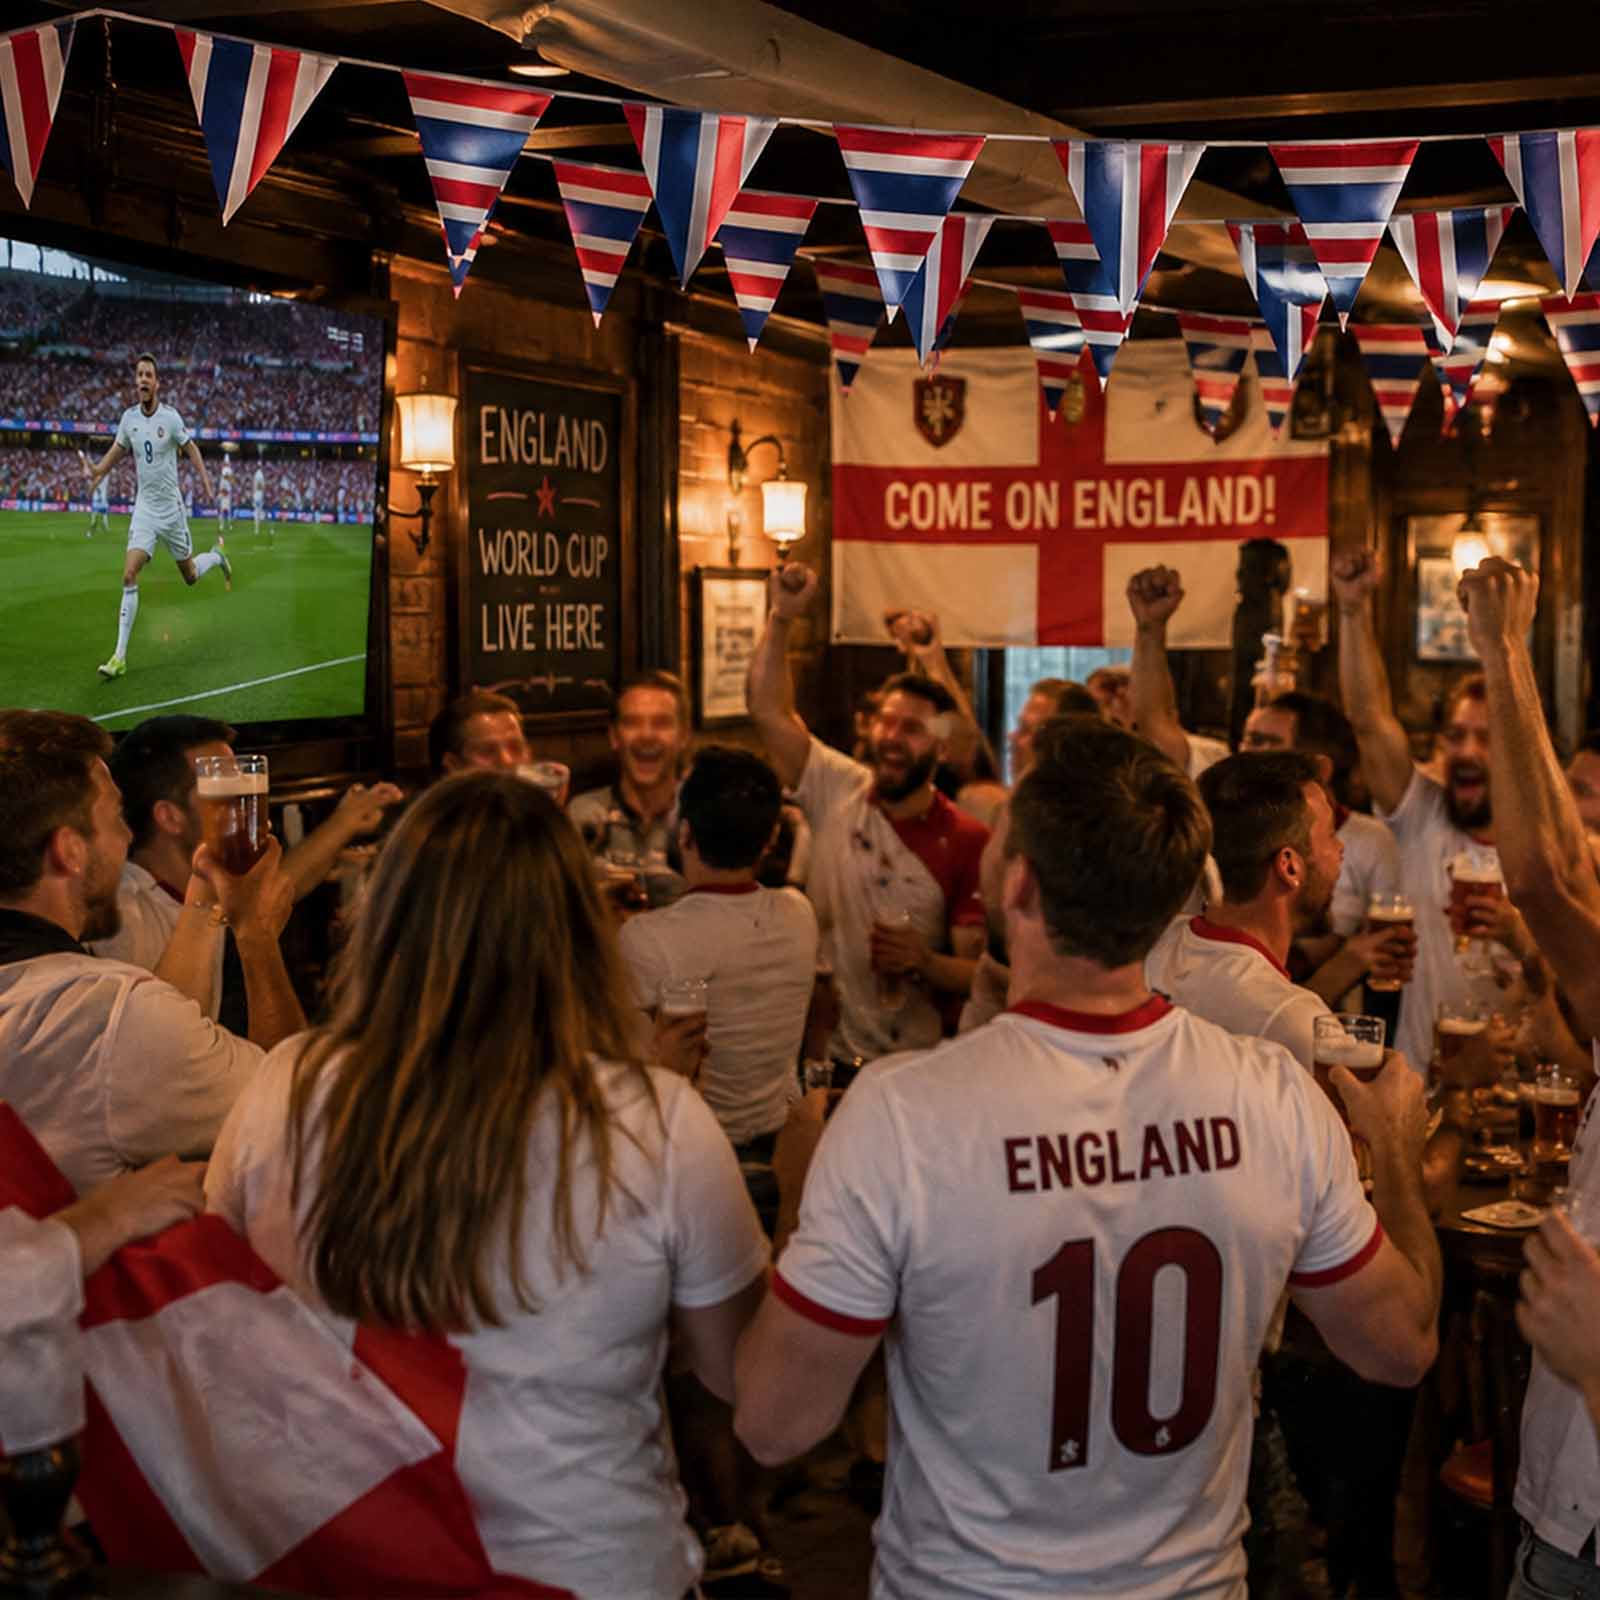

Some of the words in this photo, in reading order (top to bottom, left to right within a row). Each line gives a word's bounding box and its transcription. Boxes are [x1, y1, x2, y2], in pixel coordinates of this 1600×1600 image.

[143, 440, 153, 464] 8
[480, 405, 607, 473] ENGLAND
[884, 482, 993, 530] COME
[1005, 481, 1060, 530] ON
[1073, 475, 1277, 528] ENGLAND!
[478, 528, 560, 576] WORLD
[566, 533, 609, 578] CUP
[481, 603, 536, 652] LIVE
[546, 603, 605, 650] HERE
[1003, 1116, 1242, 1194] ENGLAND
[1030, 1225, 1224, 1474] 10
